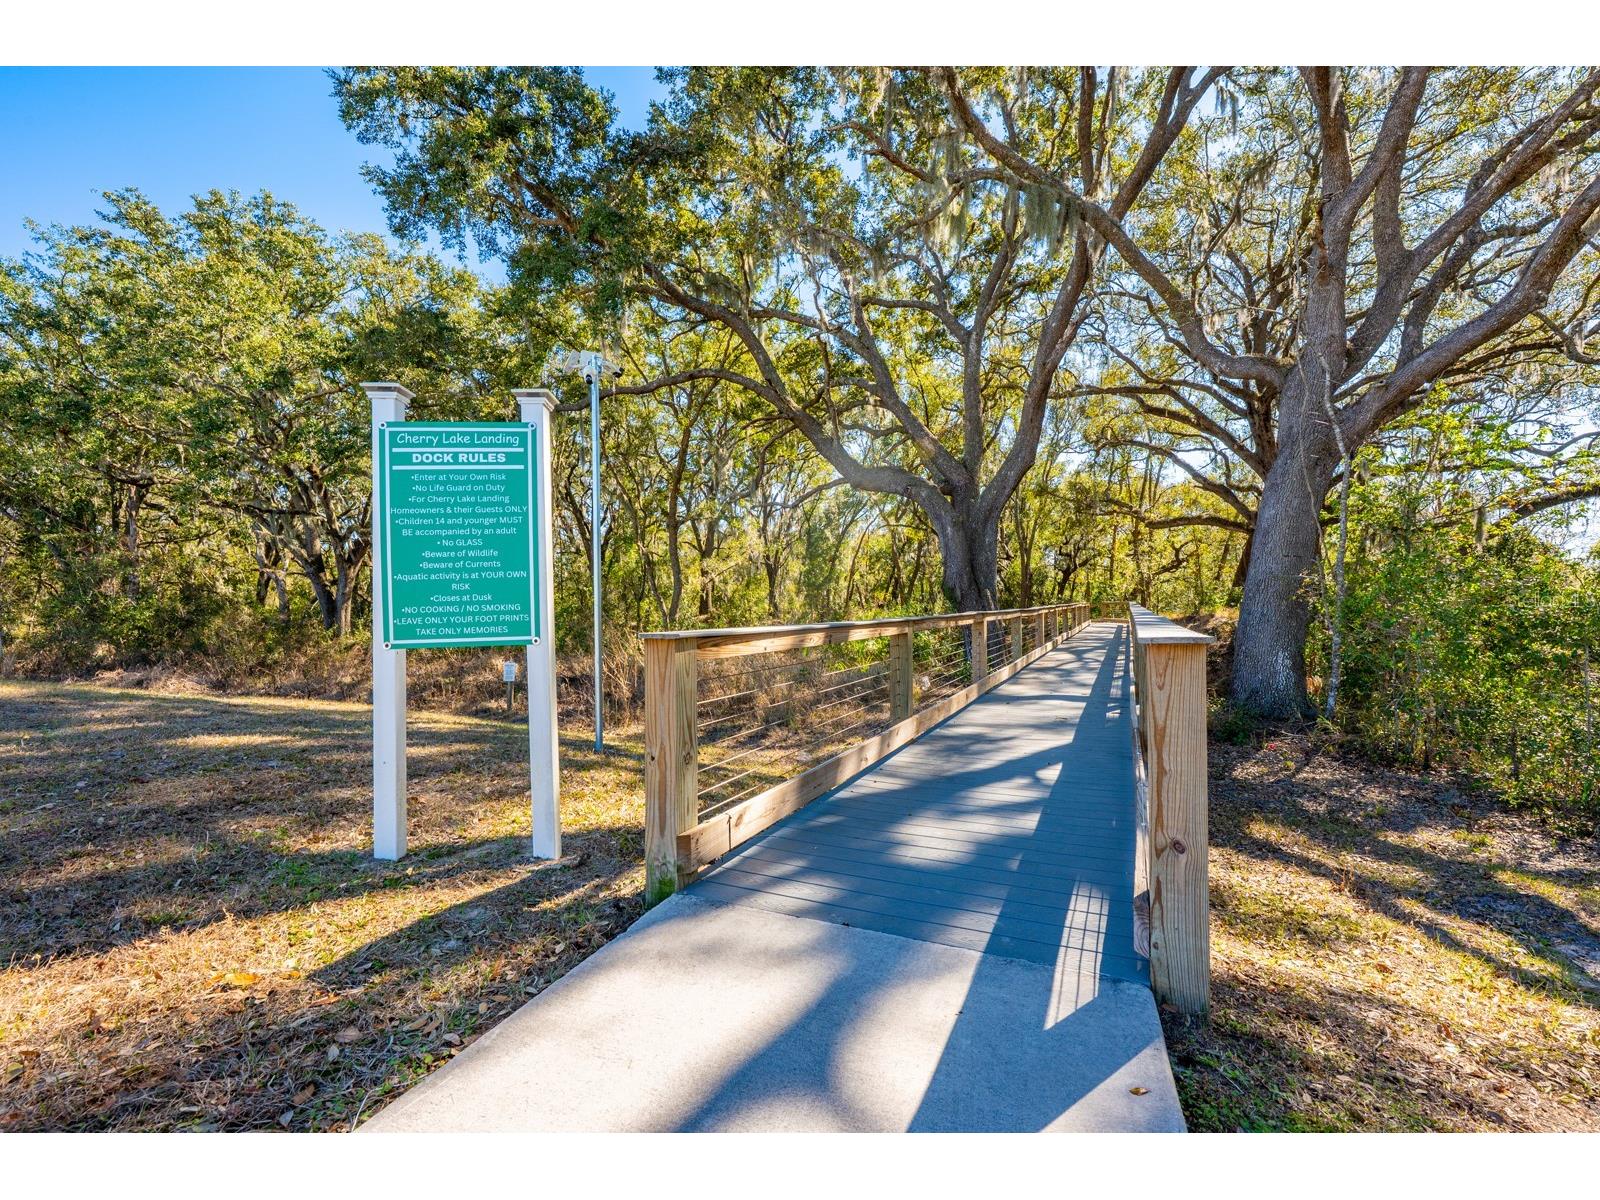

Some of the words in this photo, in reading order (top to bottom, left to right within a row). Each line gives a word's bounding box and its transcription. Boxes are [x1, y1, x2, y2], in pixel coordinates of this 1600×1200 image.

[397, 433, 438, 445] Cherry
[443, 433, 470, 444] Lake
[474, 433, 519, 445] Landing
[412, 454, 453, 463] DOCK
[459, 454, 506, 462] RULES
[430, 572, 460, 580] activity
